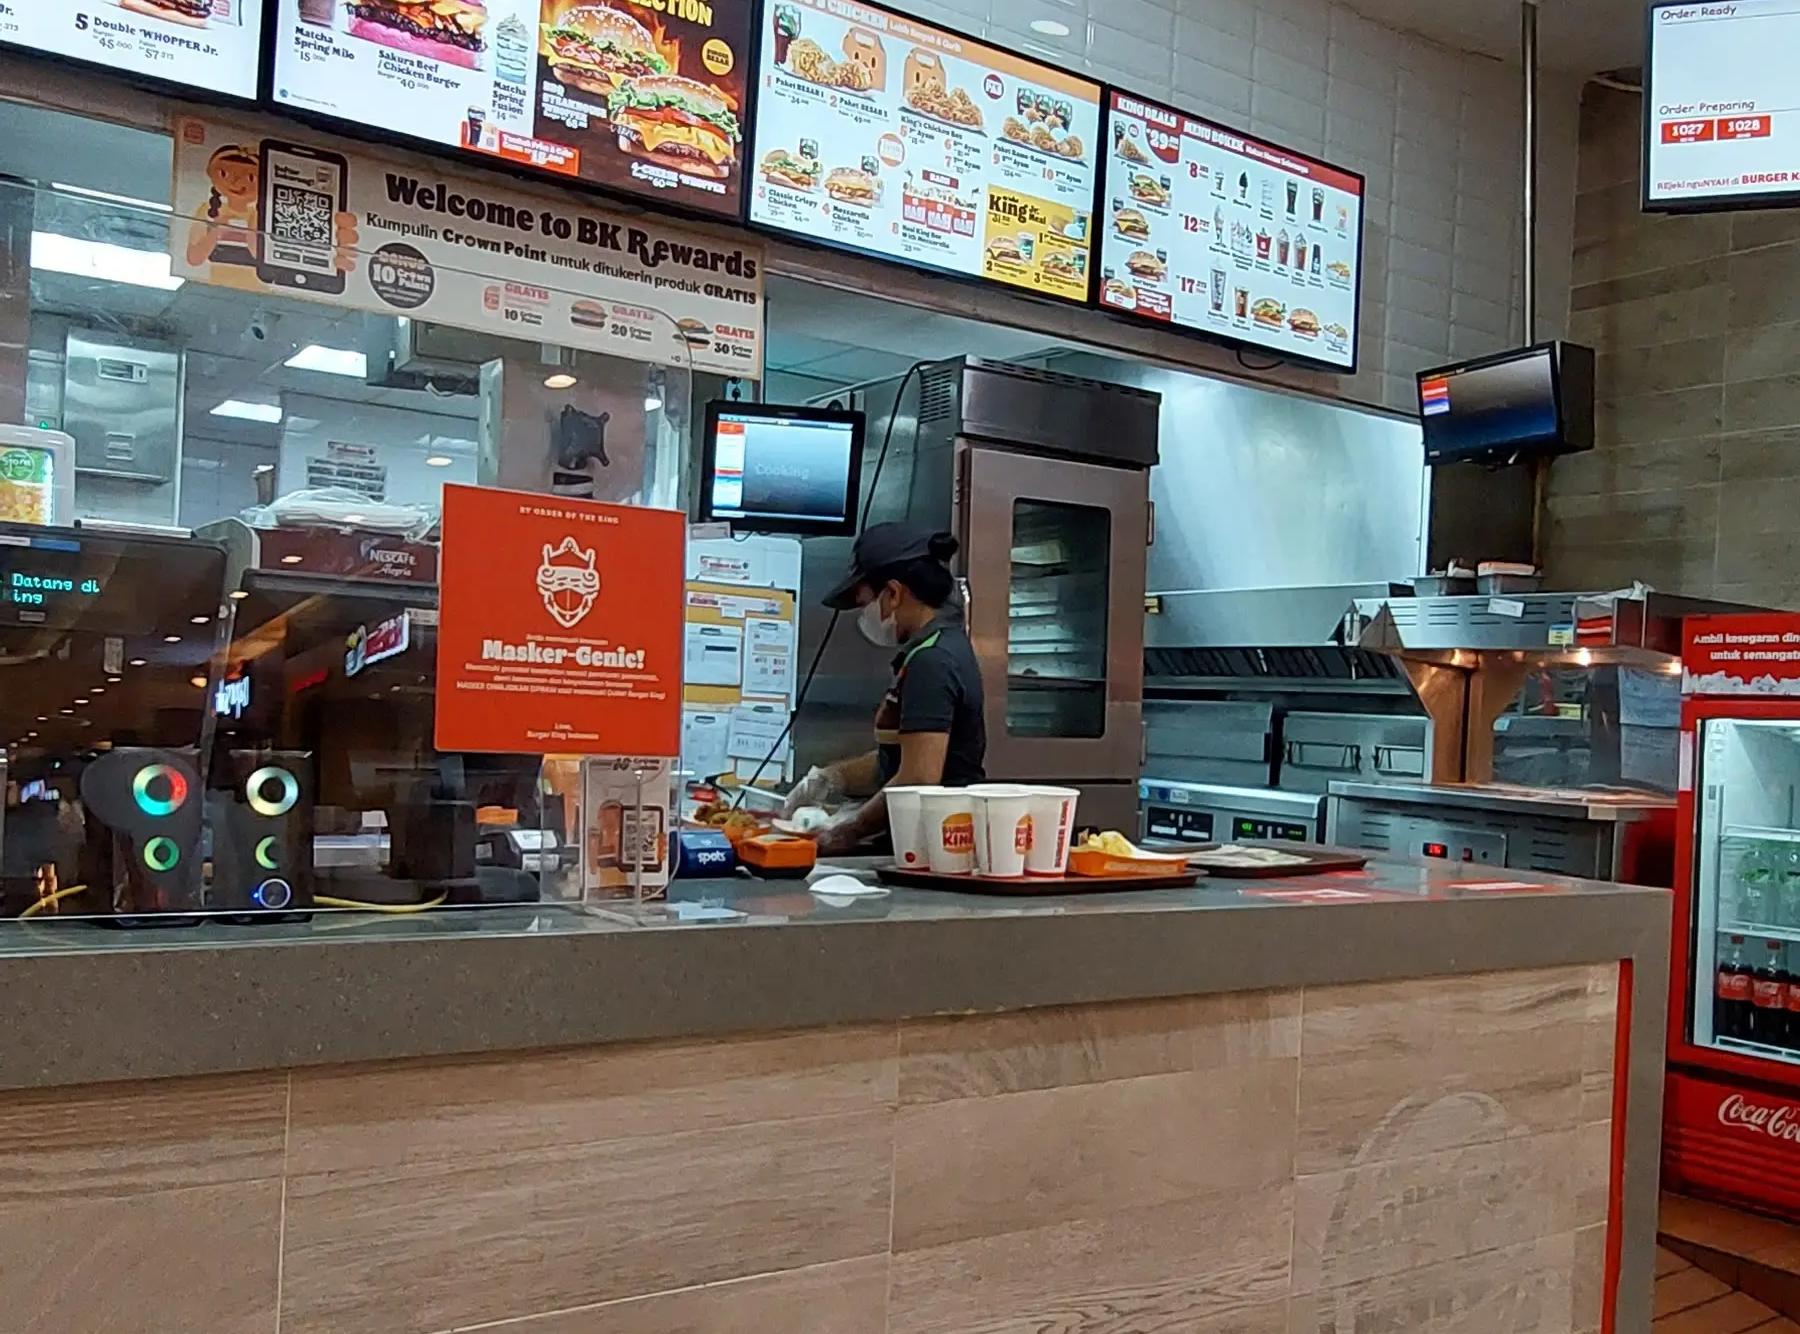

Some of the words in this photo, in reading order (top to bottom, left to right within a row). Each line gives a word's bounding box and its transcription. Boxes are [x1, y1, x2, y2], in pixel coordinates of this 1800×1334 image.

[1660, 8, 1696, 21] Order
[1700, 4, 1738, 17] Ready
[75, 13, 88, 30] 5
[93, 16, 137, 36] Double
[202, 45, 219, 56] Jr.
[295, 25, 334, 44] Matcha
[294, 37, 330, 56] Spring
[332, 47, 355, 60] Milo
[378, 49, 415, 67] Sakura
[383, 61, 425, 79] Chicken
[426, 72, 461, 90] Burger
[493, 80, 527, 96] Matcha
[492, 90, 525, 107] Spring
[829, 95, 838, 107] 2
[492, 100, 524, 116] Fusion
[1659, 103, 1695, 116] Order
[1699, 99, 1756, 114] Preparing
[1671, 122, 1706, 137] 1027
[1727, 118, 1762, 133] 1028
[993, 153, 1000, 165] 9
[1042, 167, 1054, 180] 10
[1741, 172, 1788, 185] BURGER
[768, 197, 797, 209] Chicken
[769, 189, 794, 201] Classic
[794, 195, 818, 208] Crispy
[989, 194, 1029, 224] King
[385, 172, 535, 231] Welcome
[540, 212, 572, 240] to
[577, 217, 623, 252] BK
[627, 228, 757, 280] Rewards
[365, 212, 439, 241] Kumpulin
[442, 228, 501, 254] Crown
[504, 240, 548, 263] Point
[550, 253, 591, 273] untuk
[592, 260, 653, 285] ditukerin
[654, 274, 701, 295] produk
[703, 281, 757, 305] GRATIS
[986, 260, 993, 271] 2
[372, 263, 396, 284] 10
[396, 268, 433, 284] Crown
[1034, 272, 1041, 283] 3
[504, 282, 550, 302] GRATIS
[503, 308, 519, 321] 10
[611, 323, 628, 337] 20
[714, 323, 756, 341] GRATIS
[713, 341, 730, 356] 30
[12, 572, 73, 591] Datang
[81, 579, 100, 593] di
[1693, 633, 1724, 645] Ambil
[1725, 633, 1780, 649] kesegaran
[481, 638, 646, 670] Masker-Genic!
[1710, 650, 1741, 661] untuk
[1743, 651, 1800, 665] semangat
[697, 850, 727, 864] spots
